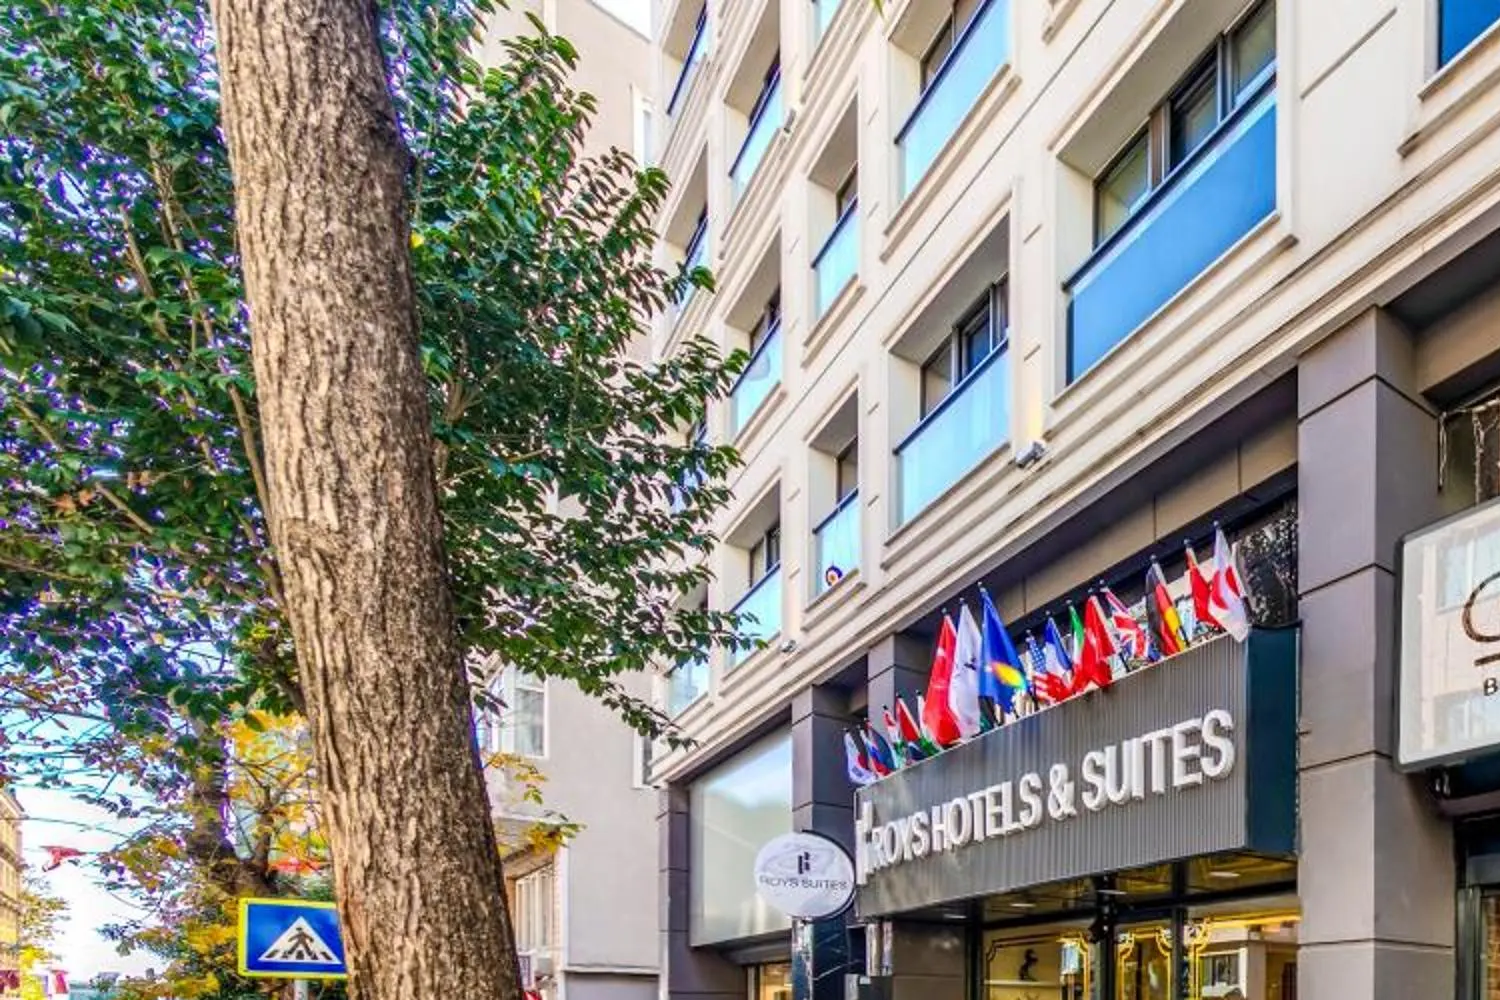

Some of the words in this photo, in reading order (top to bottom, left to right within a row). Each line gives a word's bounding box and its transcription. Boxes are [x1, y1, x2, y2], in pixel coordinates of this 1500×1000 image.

[871, 811, 931, 869] ROYS
[931, 772, 1043, 852] HOTELS
[1047, 762, 1077, 821] &
[1081, 708, 1236, 812] SUITES
[759, 874, 799, 888] ROYS
[801, 878, 849, 891] SUITES
